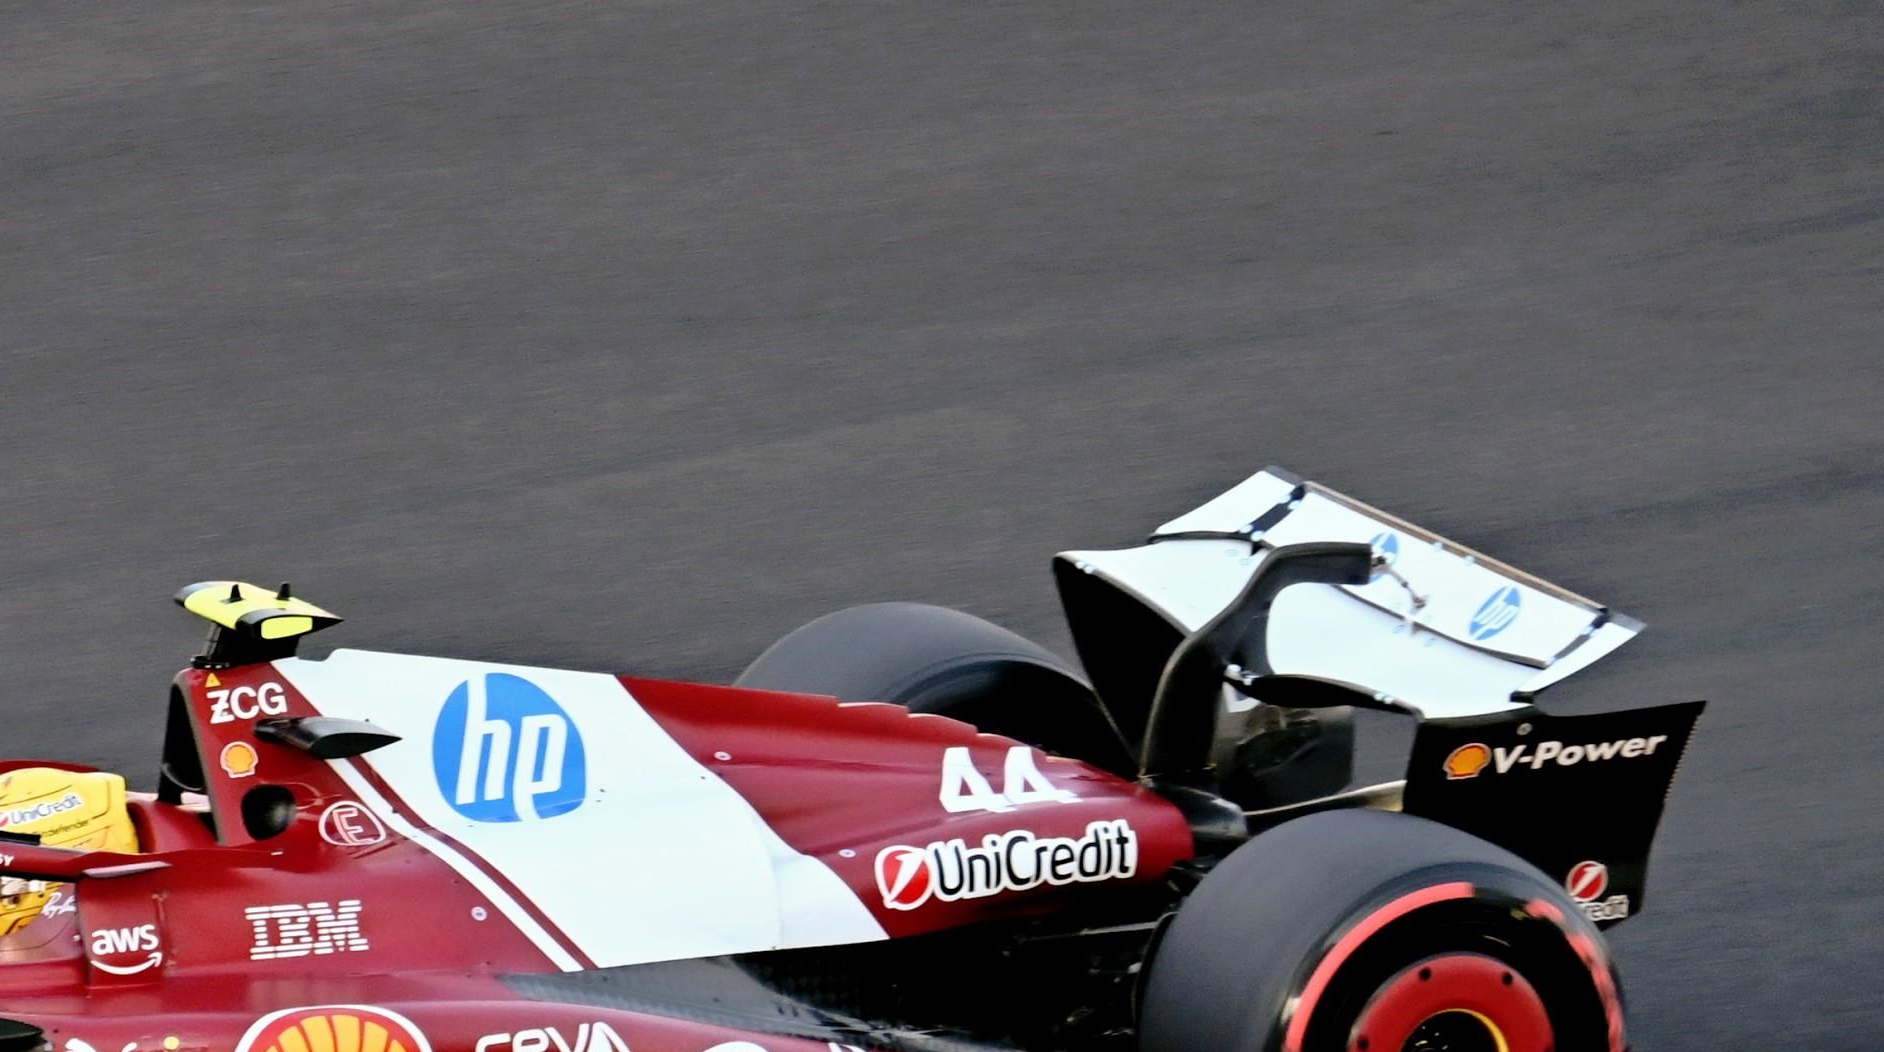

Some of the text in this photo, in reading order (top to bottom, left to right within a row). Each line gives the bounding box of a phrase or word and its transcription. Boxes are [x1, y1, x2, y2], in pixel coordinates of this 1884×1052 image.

[206, 682, 288, 724] ZCG
[456, 671, 568, 822] hp
[1493, 735, 1668, 774] V-Power
[940, 747, 1083, 813] 44
[12, 796, 82, 824] UniCredit
[935, 825, 1131, 896] UniCredit
[91, 924, 160, 957] aws
[244, 900, 370, 960] IBM
